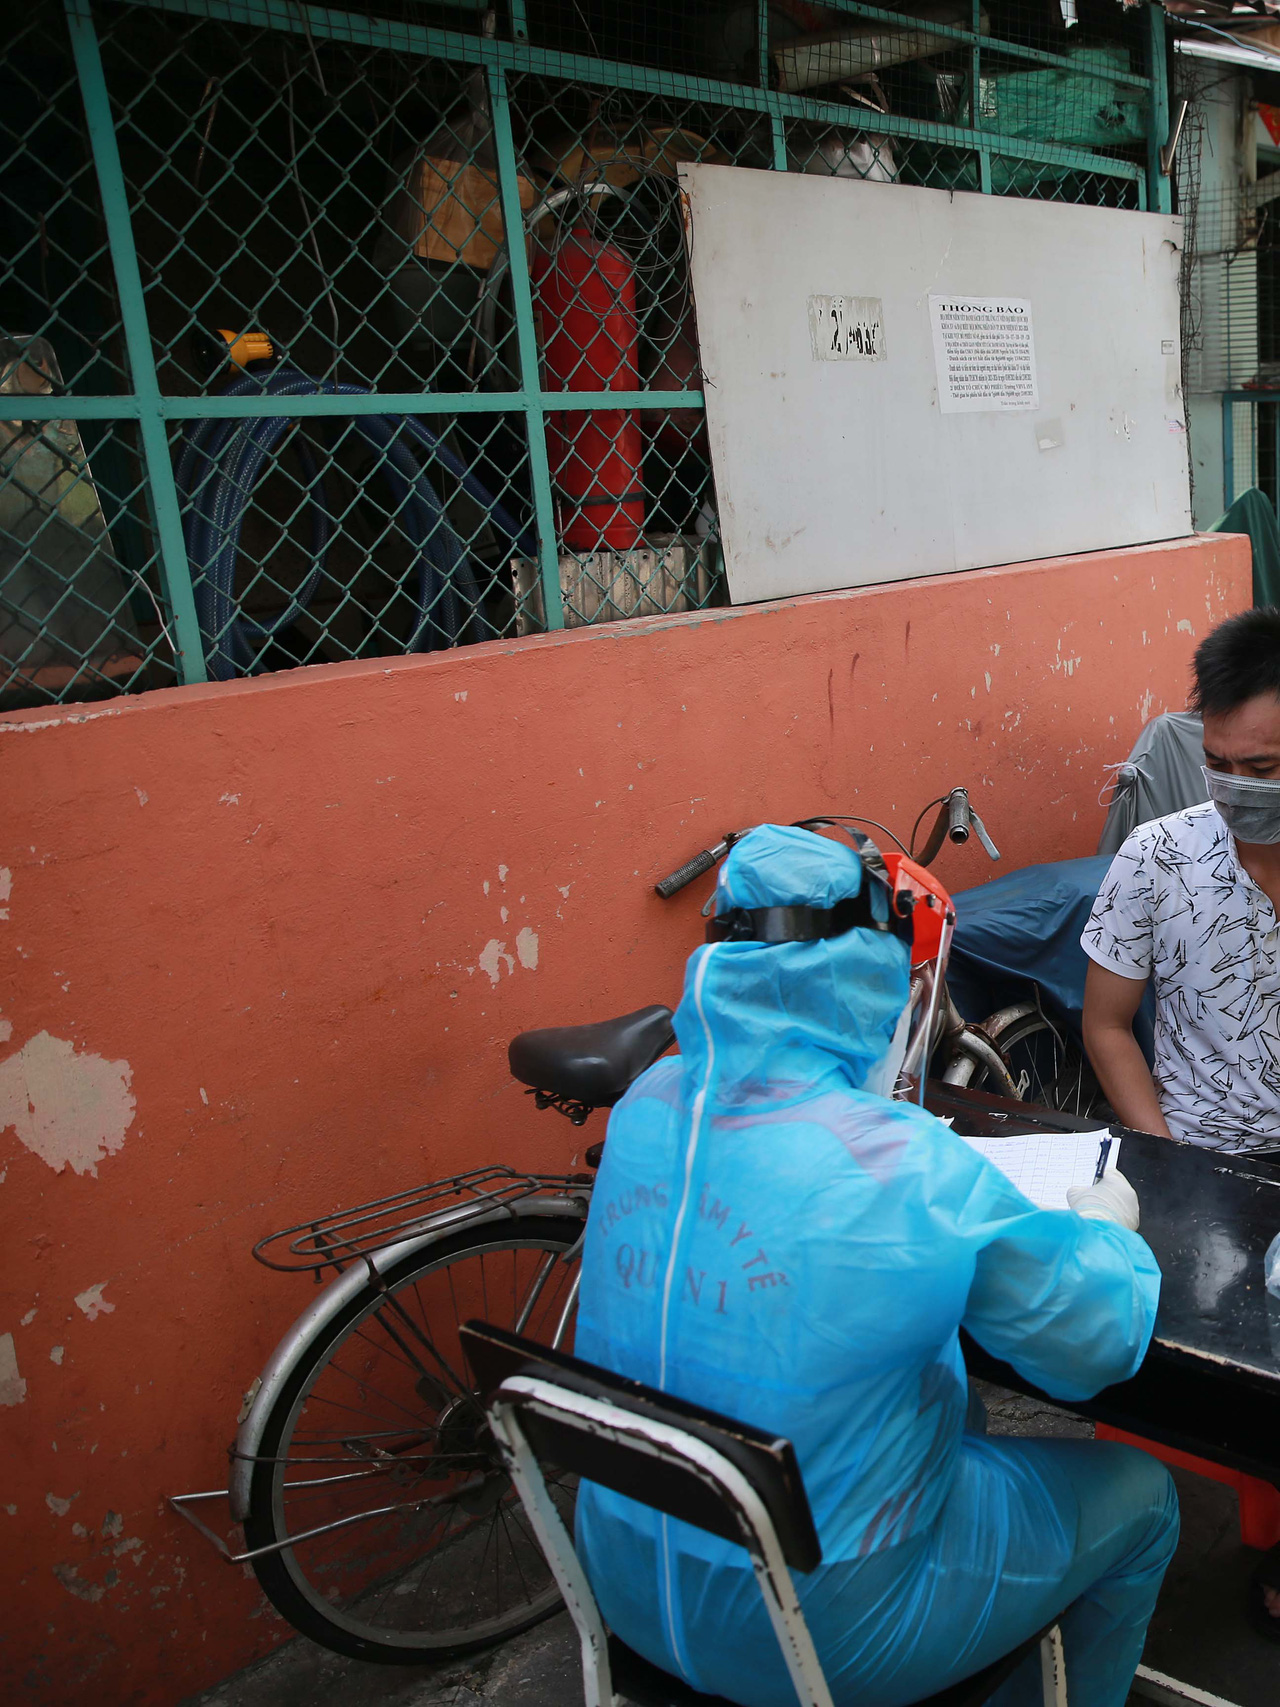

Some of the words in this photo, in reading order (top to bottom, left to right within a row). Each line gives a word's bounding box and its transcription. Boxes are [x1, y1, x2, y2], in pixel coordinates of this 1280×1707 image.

[939, 304, 993, 313] THÔNG
[996, 306, 1023, 314] BÁO
[729, 1221, 753, 1247] Y
